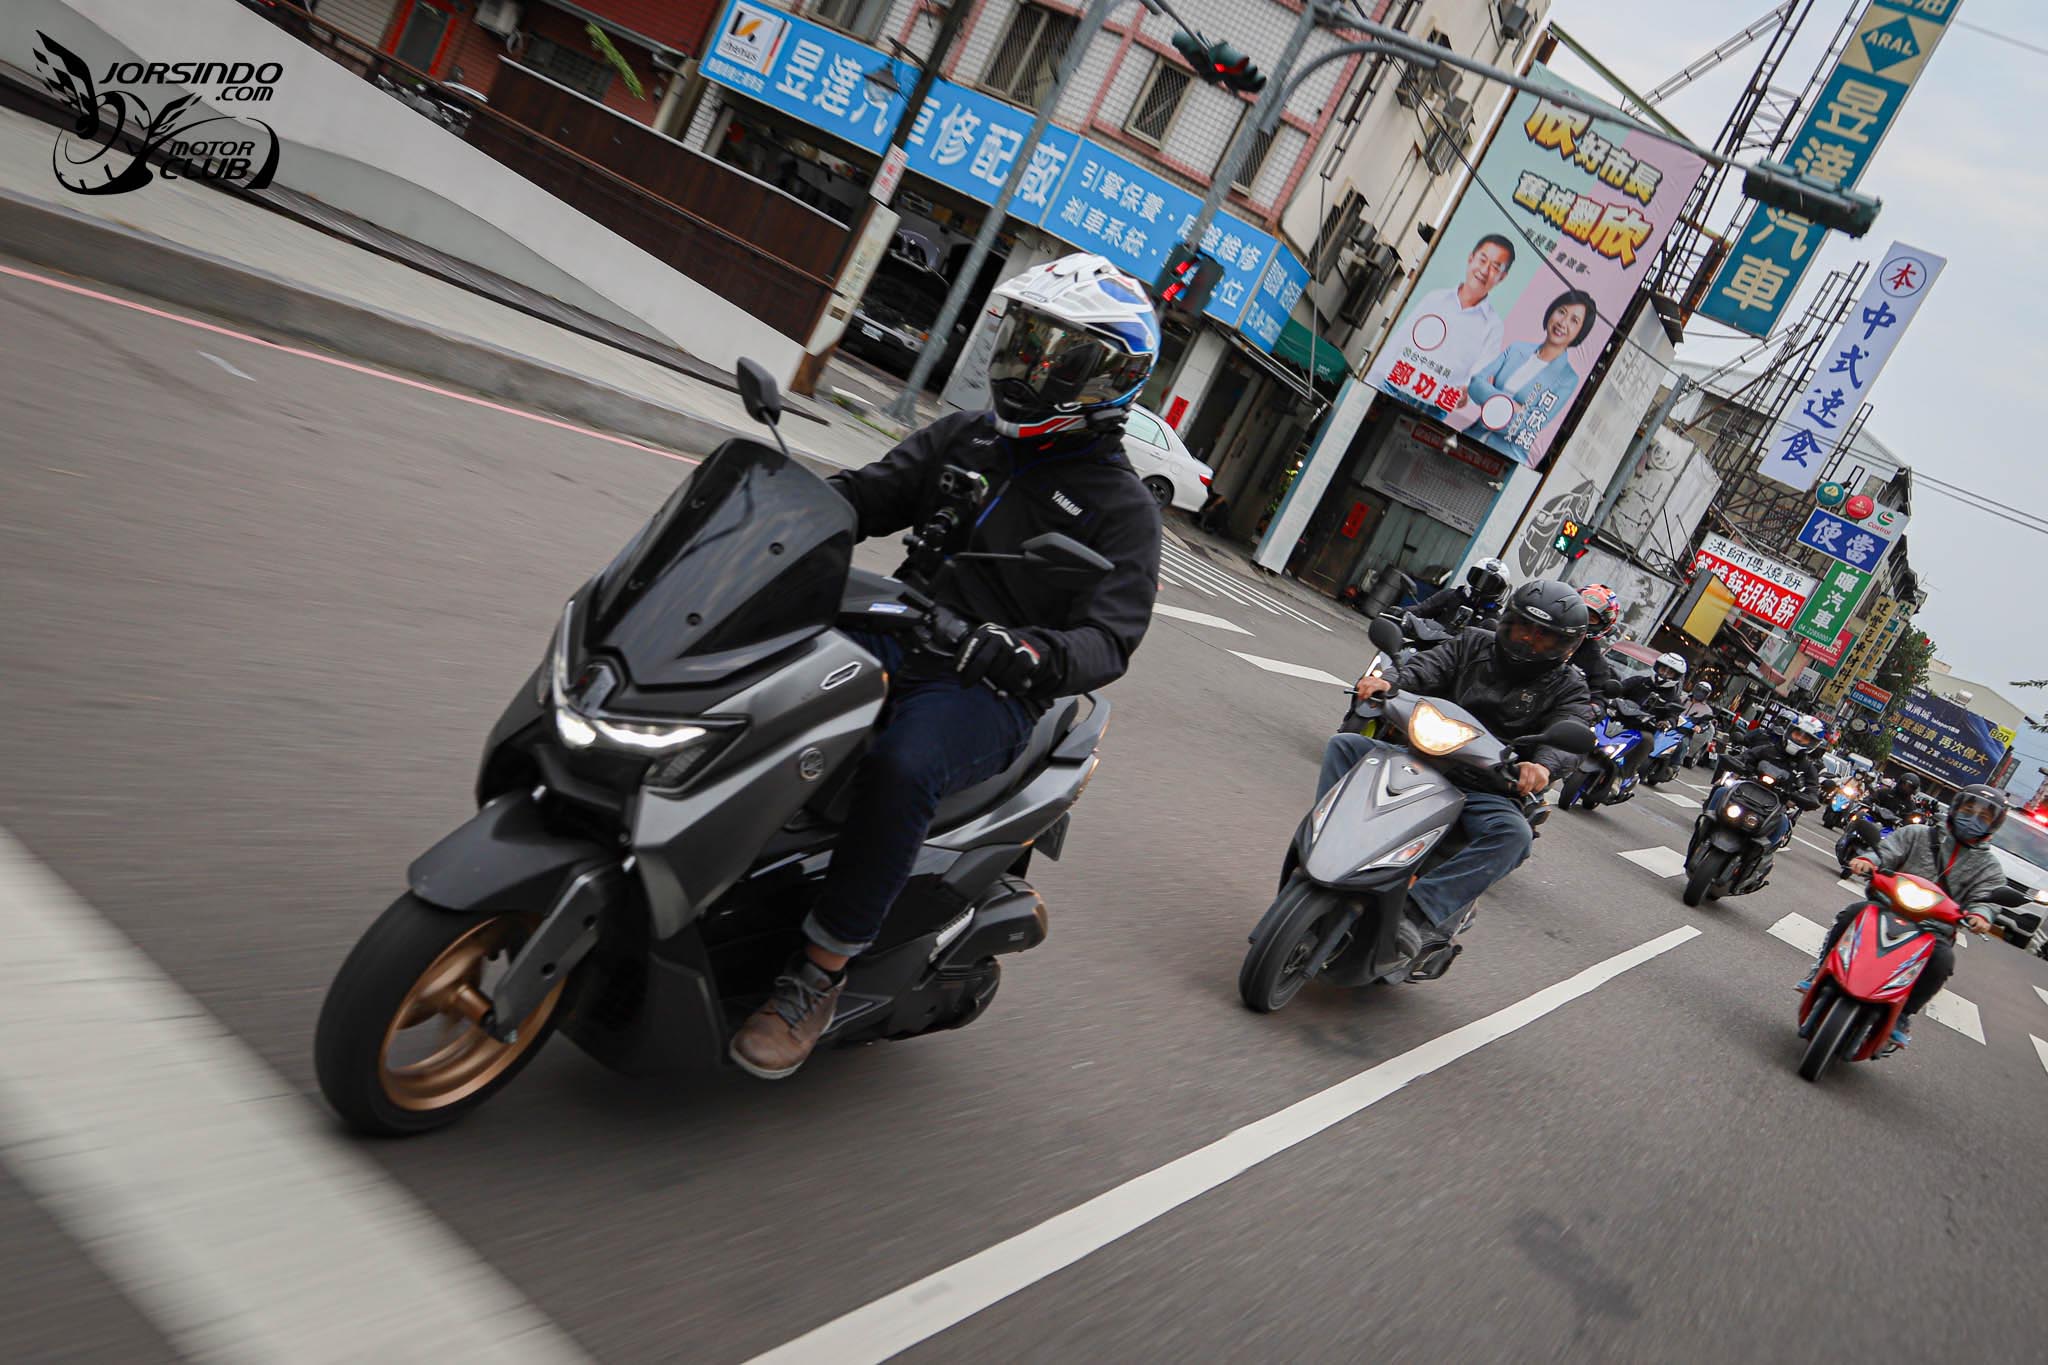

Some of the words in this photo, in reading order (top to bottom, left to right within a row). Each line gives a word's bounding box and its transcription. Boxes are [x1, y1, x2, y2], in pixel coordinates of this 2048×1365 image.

[1864, 29, 1915, 57] ARAL
[1512, 169, 1654, 269] 舊城翻欣
[1386, 360, 1462, 413] 鄭功進
[1781, 301, 1897, 469] 中式速食
[1514, 389, 1560, 450] 何欣純
[1813, 517, 1875, 565] 便當
[1866, 521, 1892, 536] Castrol
[1707, 538, 1804, 590] 洪師傅燒餅
[1811, 566, 1860, 630] 暉汽車
